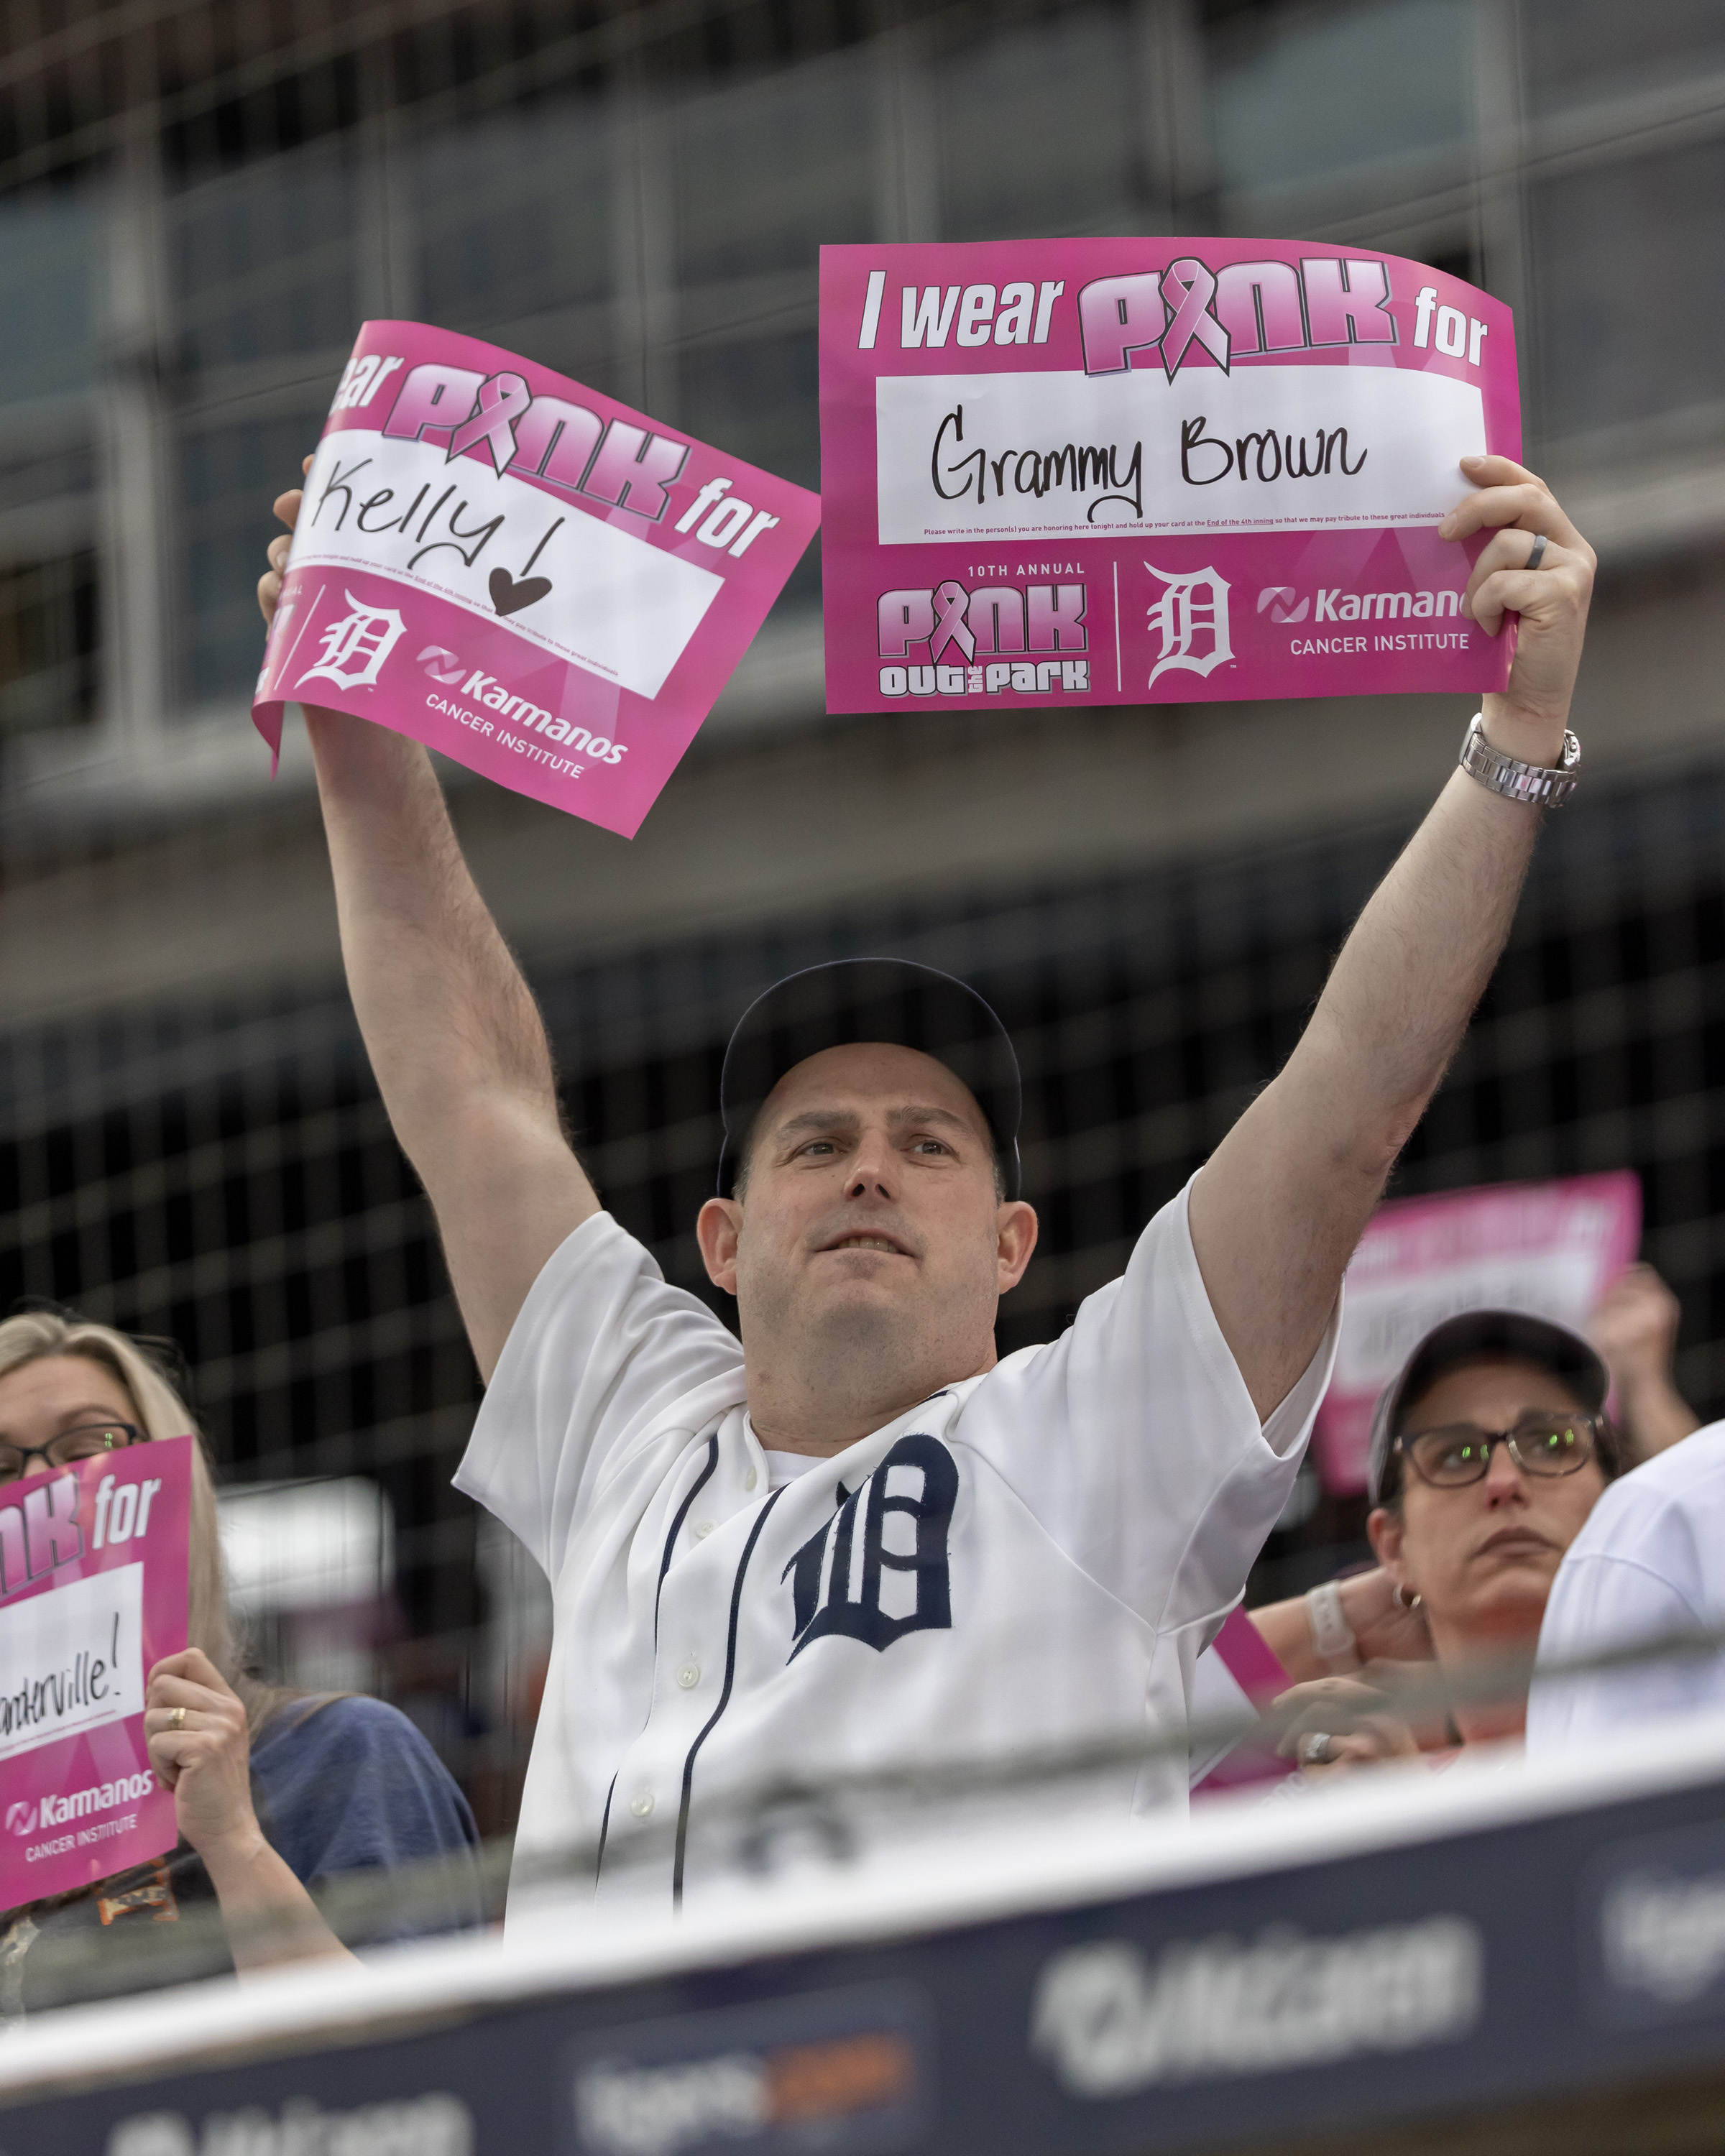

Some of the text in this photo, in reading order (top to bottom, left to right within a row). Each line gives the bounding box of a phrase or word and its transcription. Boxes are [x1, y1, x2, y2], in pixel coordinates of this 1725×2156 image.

[857, 270, 887, 349] I
[901, 280, 1065, 349] wear
[1412, 286, 1489, 367] for
[932, 404, 1368, 523] Grammy Brown
[673, 476, 781, 559] for
[985, 526, 1017, 535] person(s)
[1044, 525, 1073, 533] honoring
[968, 563, 1085, 577] 10TH ANNUAL
[1315, 589, 1465, 622] Karman
[1290, 633, 1469, 655] CANCER INSTITUTE
[426, 694, 585, 779] CANCER INSTITUTE
[460, 670, 628, 765] Karmanos
[92, 1473, 162, 1550] for
[40, 1769, 153, 1828] Karmanos
[25, 1813, 137, 1863] CANCER INSTITUTE
